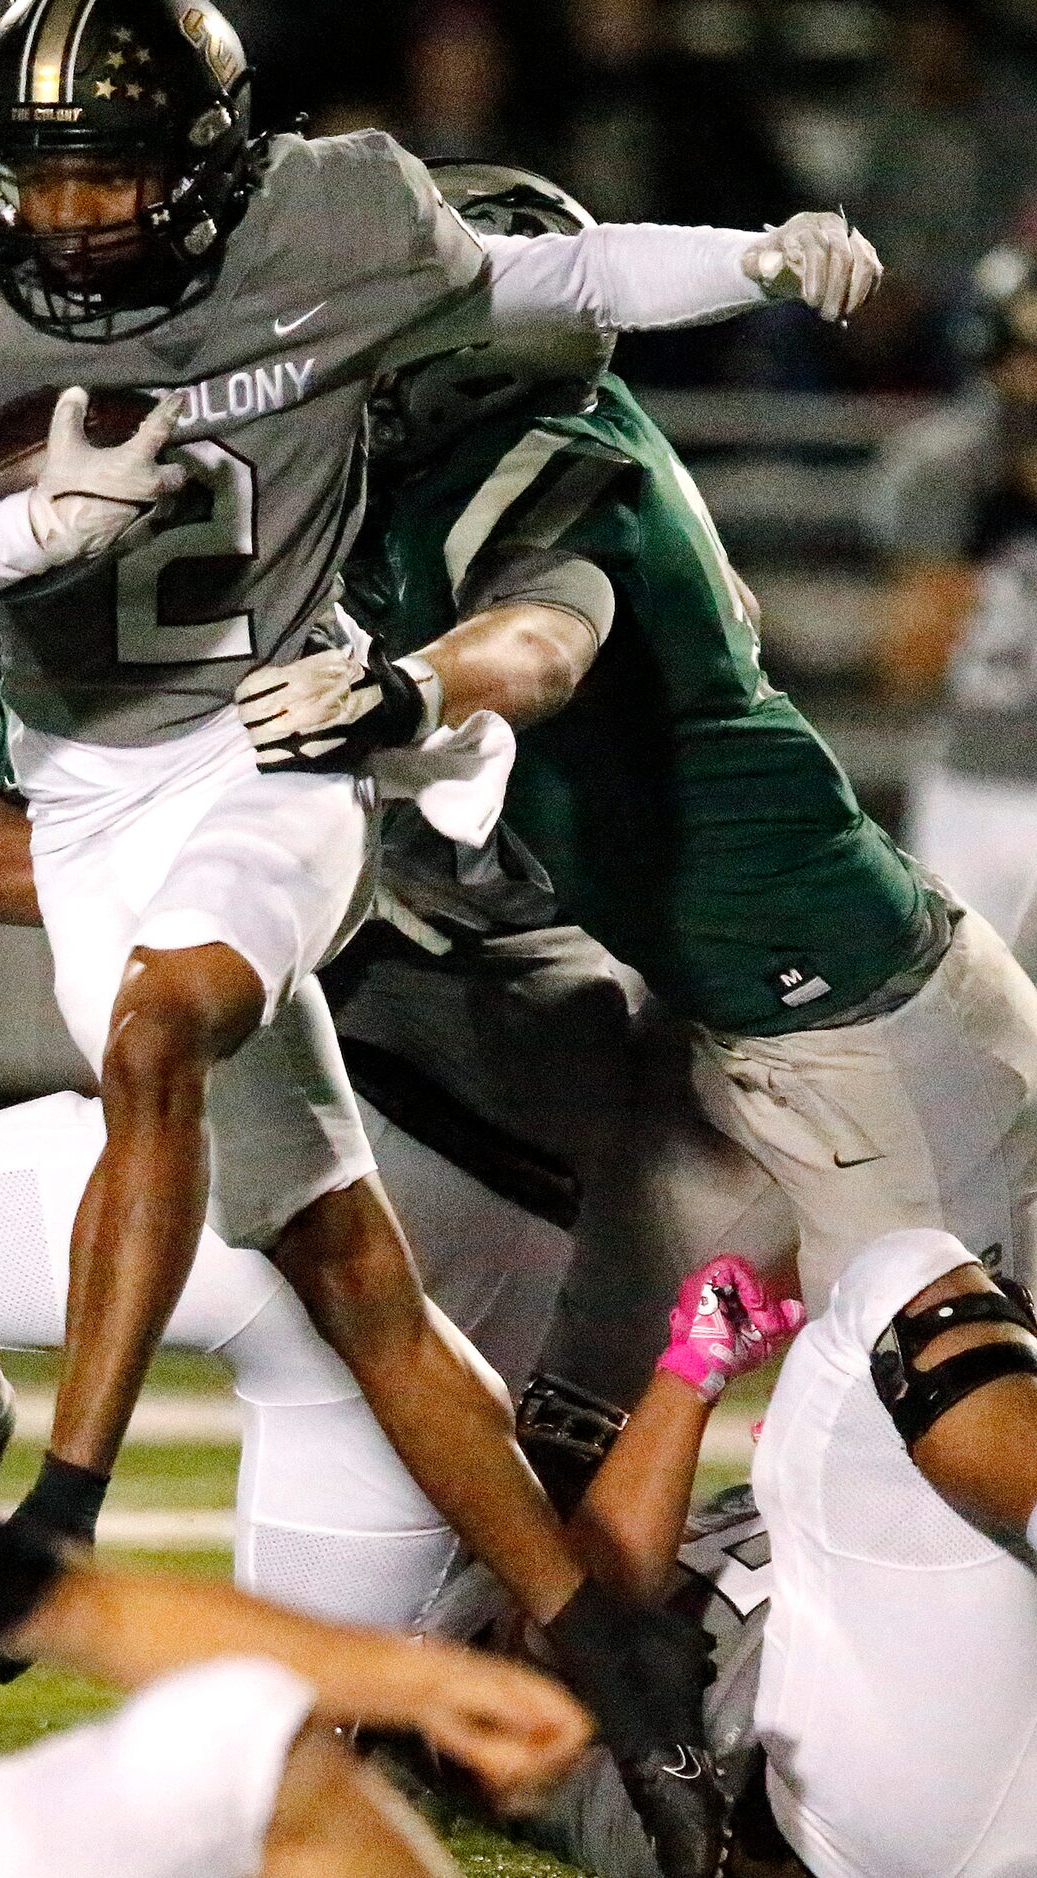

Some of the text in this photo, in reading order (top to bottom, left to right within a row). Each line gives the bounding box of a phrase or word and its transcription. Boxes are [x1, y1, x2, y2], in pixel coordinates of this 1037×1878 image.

[151, 358, 316, 428] OLONY
[116, 437, 257, 665] 2
[779, 968, 803, 988] M
